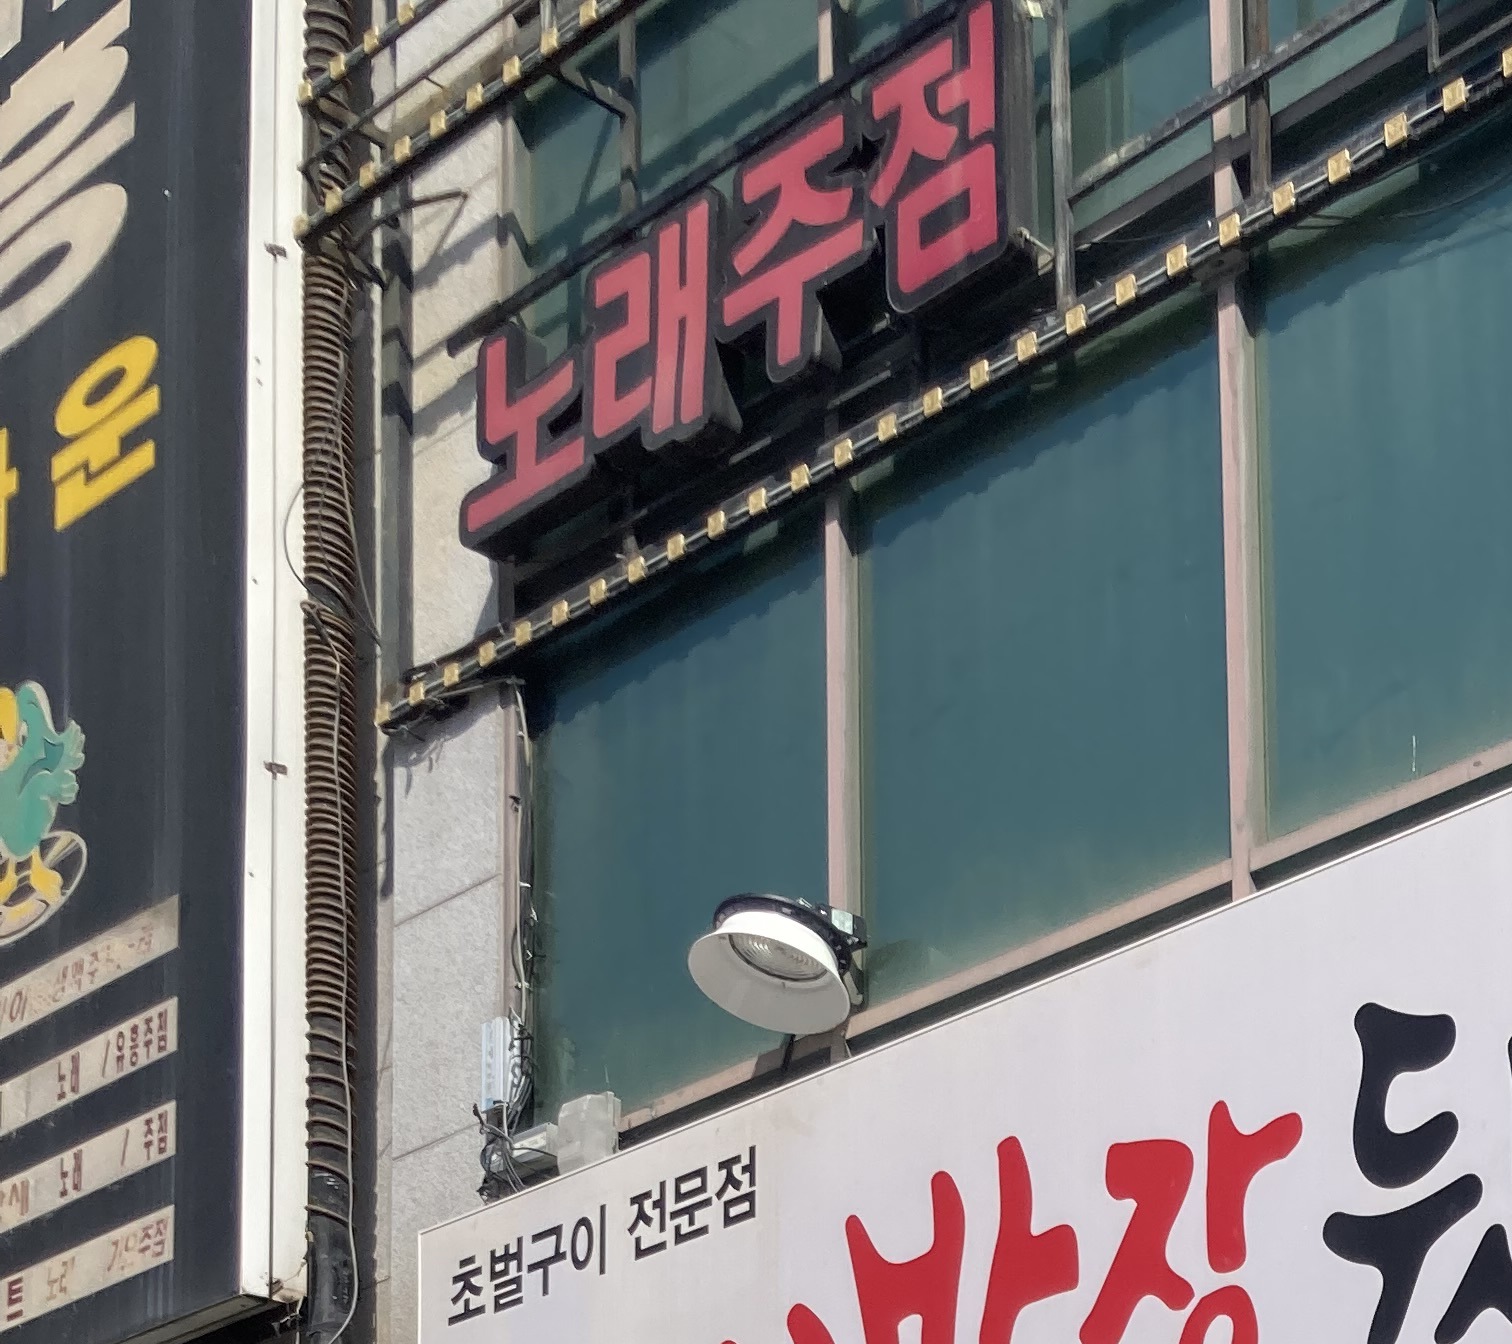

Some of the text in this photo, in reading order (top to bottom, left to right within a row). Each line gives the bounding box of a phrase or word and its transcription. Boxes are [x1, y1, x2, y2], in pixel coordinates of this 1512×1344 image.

[465, 0, 999, 534] 노래주점
[60, 1149, 83, 1198] 노래
[144, 1110, 168, 1160] 주점
[448, 1145, 757, 1326] 초벌구이 전문점
